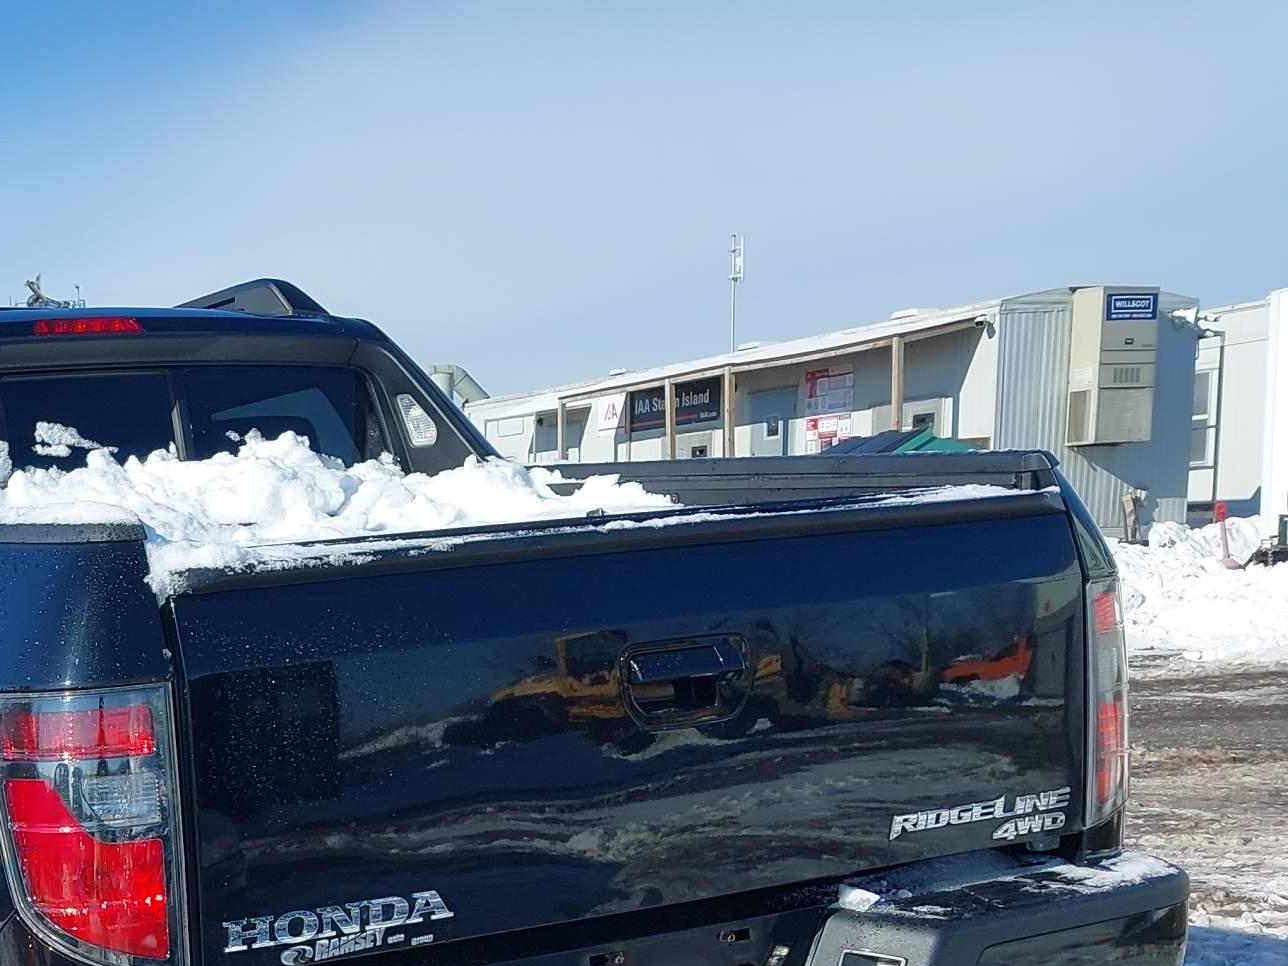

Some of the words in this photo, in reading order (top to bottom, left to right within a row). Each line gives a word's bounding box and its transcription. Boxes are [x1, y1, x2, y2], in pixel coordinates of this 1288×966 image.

[1115, 300, 1150, 308] WILLSCOT
[634, 399, 650, 415] IAA
[682, 388, 710, 407] Island
[889, 786, 1071, 841] RIDGELINE
[992, 811, 1066, 841] 4WD
[222, 890, 454, 953] HONDA
[314, 927, 386, 961] RAMSEY
